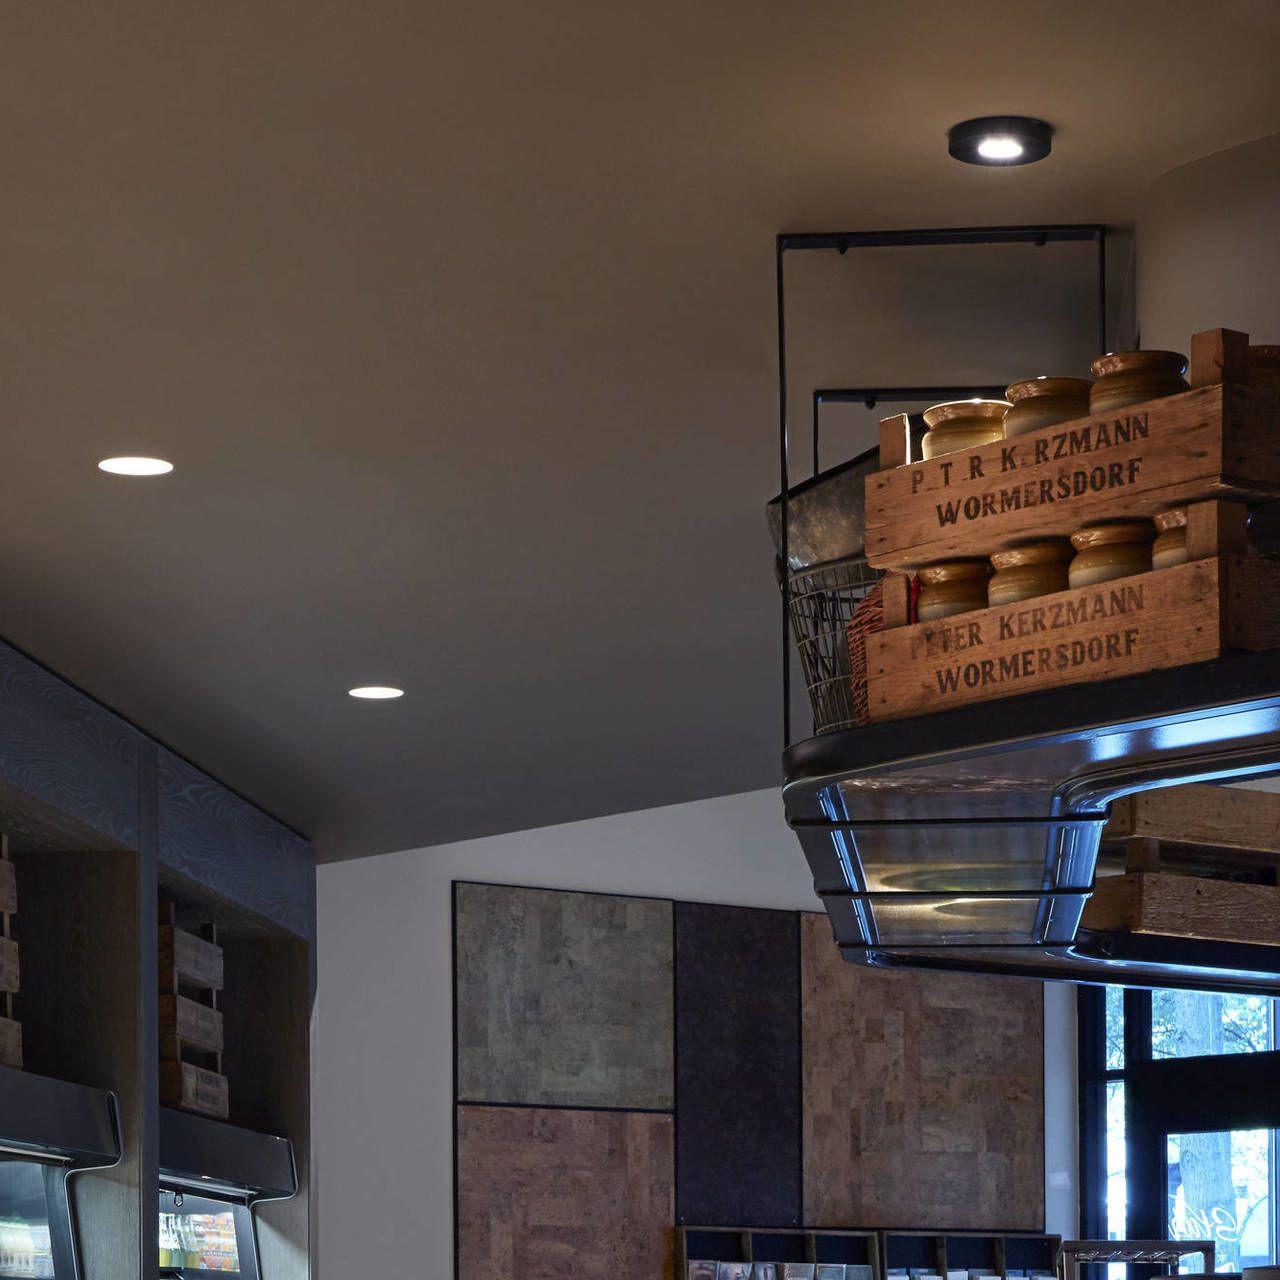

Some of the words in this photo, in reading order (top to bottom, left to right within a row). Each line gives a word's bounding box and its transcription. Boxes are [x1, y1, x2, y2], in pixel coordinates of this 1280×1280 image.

[1001, 413, 1150, 472] KRZMANN
[936, 457, 1143, 527] WORMERSDORF
[999, 584, 1145, 642] KERZMANN
[936, 629, 1140, 694] WORMERSDORF
